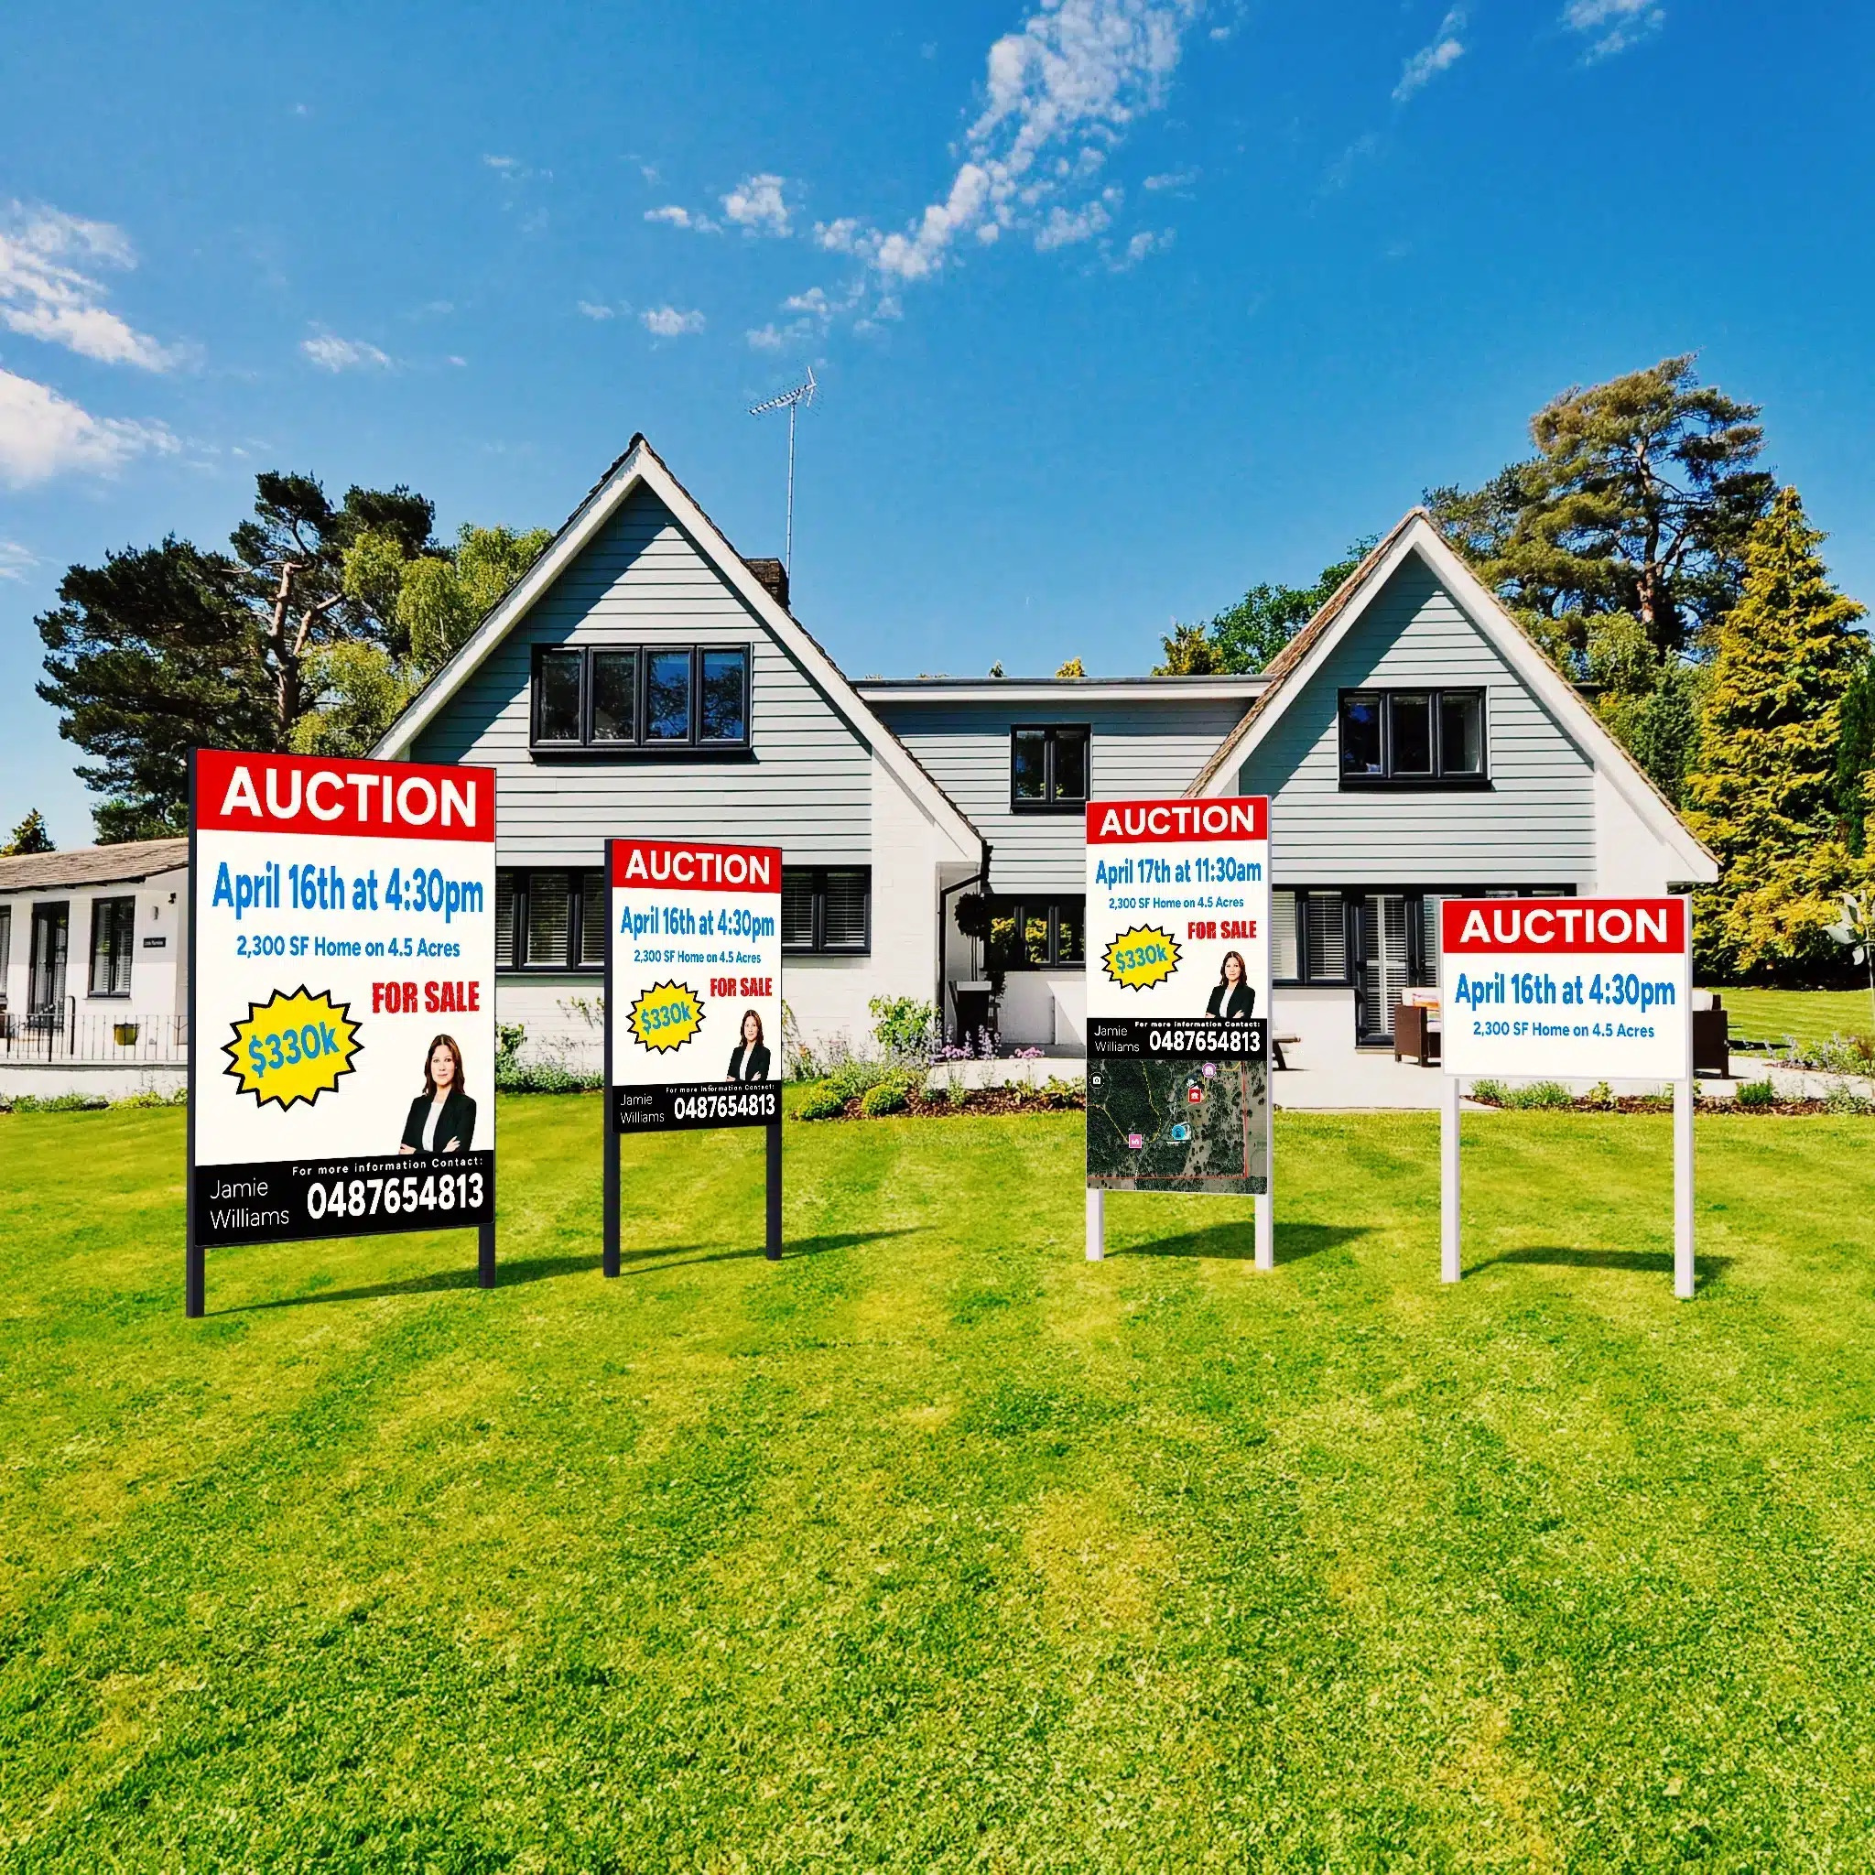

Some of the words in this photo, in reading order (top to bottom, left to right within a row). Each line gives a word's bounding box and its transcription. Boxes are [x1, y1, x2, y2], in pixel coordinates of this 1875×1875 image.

[220, 766, 476, 827] AUCTION
[1100, 805, 1254, 836] AUCTION
[625, 850, 770, 884] AUCTION
[1096, 858, 1133, 890] April
[1138, 859, 1171, 883] 17th
[1175, 863, 1191, 883] at
[1196, 857, 1261, 883] 11:30am
[212, 862, 280, 920] April
[289, 864, 344, 910] 16th
[353, 873, 377, 911] at
[384, 868, 483, 923] 4:30pm
[1109, 898, 1136, 910] 2,300
[1138, 898, 1149, 909] SF
[1153, 897, 1181, 908] Home
[1183, 899, 1195, 908] on
[1197, 897, 1213, 908] 4.5
[1216, 897, 1244, 908] Acres
[620, 906, 658, 940] April
[663, 908, 695, 935] 16th
[700, 912, 714, 935] at
[718, 909, 774, 943] 4:30pm
[1188, 922, 1216, 939] FOR
[1221, 921, 1257, 939] SALE
[1460, 909, 1667, 943] AUCTION
[237, 936, 285, 959] 2,300
[289, 936, 310, 956] SF
[314, 937, 361, 957] Home
[366, 942, 384, 957] on
[388, 938, 412, 957] 4.5
[417, 939, 461, 958] Acres
[634, 950, 662, 963] 2,300
[664, 950, 675, 962] SF
[678, 951, 704, 963] Home
[706, 954, 718, 963] on
[720, 952, 734, 963] 4.5
[736, 952, 761, 963] Acres
[1116, 943, 1168, 973] $330k
[372, 982, 418, 1014] FOR
[424, 980, 479, 1013] SALE
[710, 978, 737, 997] FOR
[740, 978, 772, 996] SALE
[1455, 972, 1505, 1011] April
[1511, 972, 1556, 1004] 16th
[1562, 976, 1583, 1004] at
[1589, 973, 1675, 1013] 4:30pm
[641, 1001, 692, 1035] $330k
[1473, 1021, 1509, 1037] 2,300
[1513, 1022, 1528, 1036] SF
[1533, 1023, 1570, 1036] Home
[1573, 1025, 1588, 1036] on
[1593, 1023, 1613, 1037] 4.5
[1617, 1023, 1654, 1037] Acres
[1094, 1026, 1127, 1036] Jamie
[1150, 1031, 1260, 1051] 0487654813
[249, 1021, 340, 1078] $330k
[1095, 1041, 1139, 1052] Williams
[621, 1094, 652, 1105] Jamie
[675, 1094, 775, 1119] 0487654813
[621, 1112, 664, 1124] Williams
[293, 1166, 312, 1176] For
[318, 1165, 349, 1174] more
[354, 1160, 426, 1172] information
[432, 1157, 483, 1168] Contact:
[210, 1177, 268, 1199] Jamie
[307, 1172, 484, 1219] 0487654813
[210, 1209, 290, 1229] Williams
